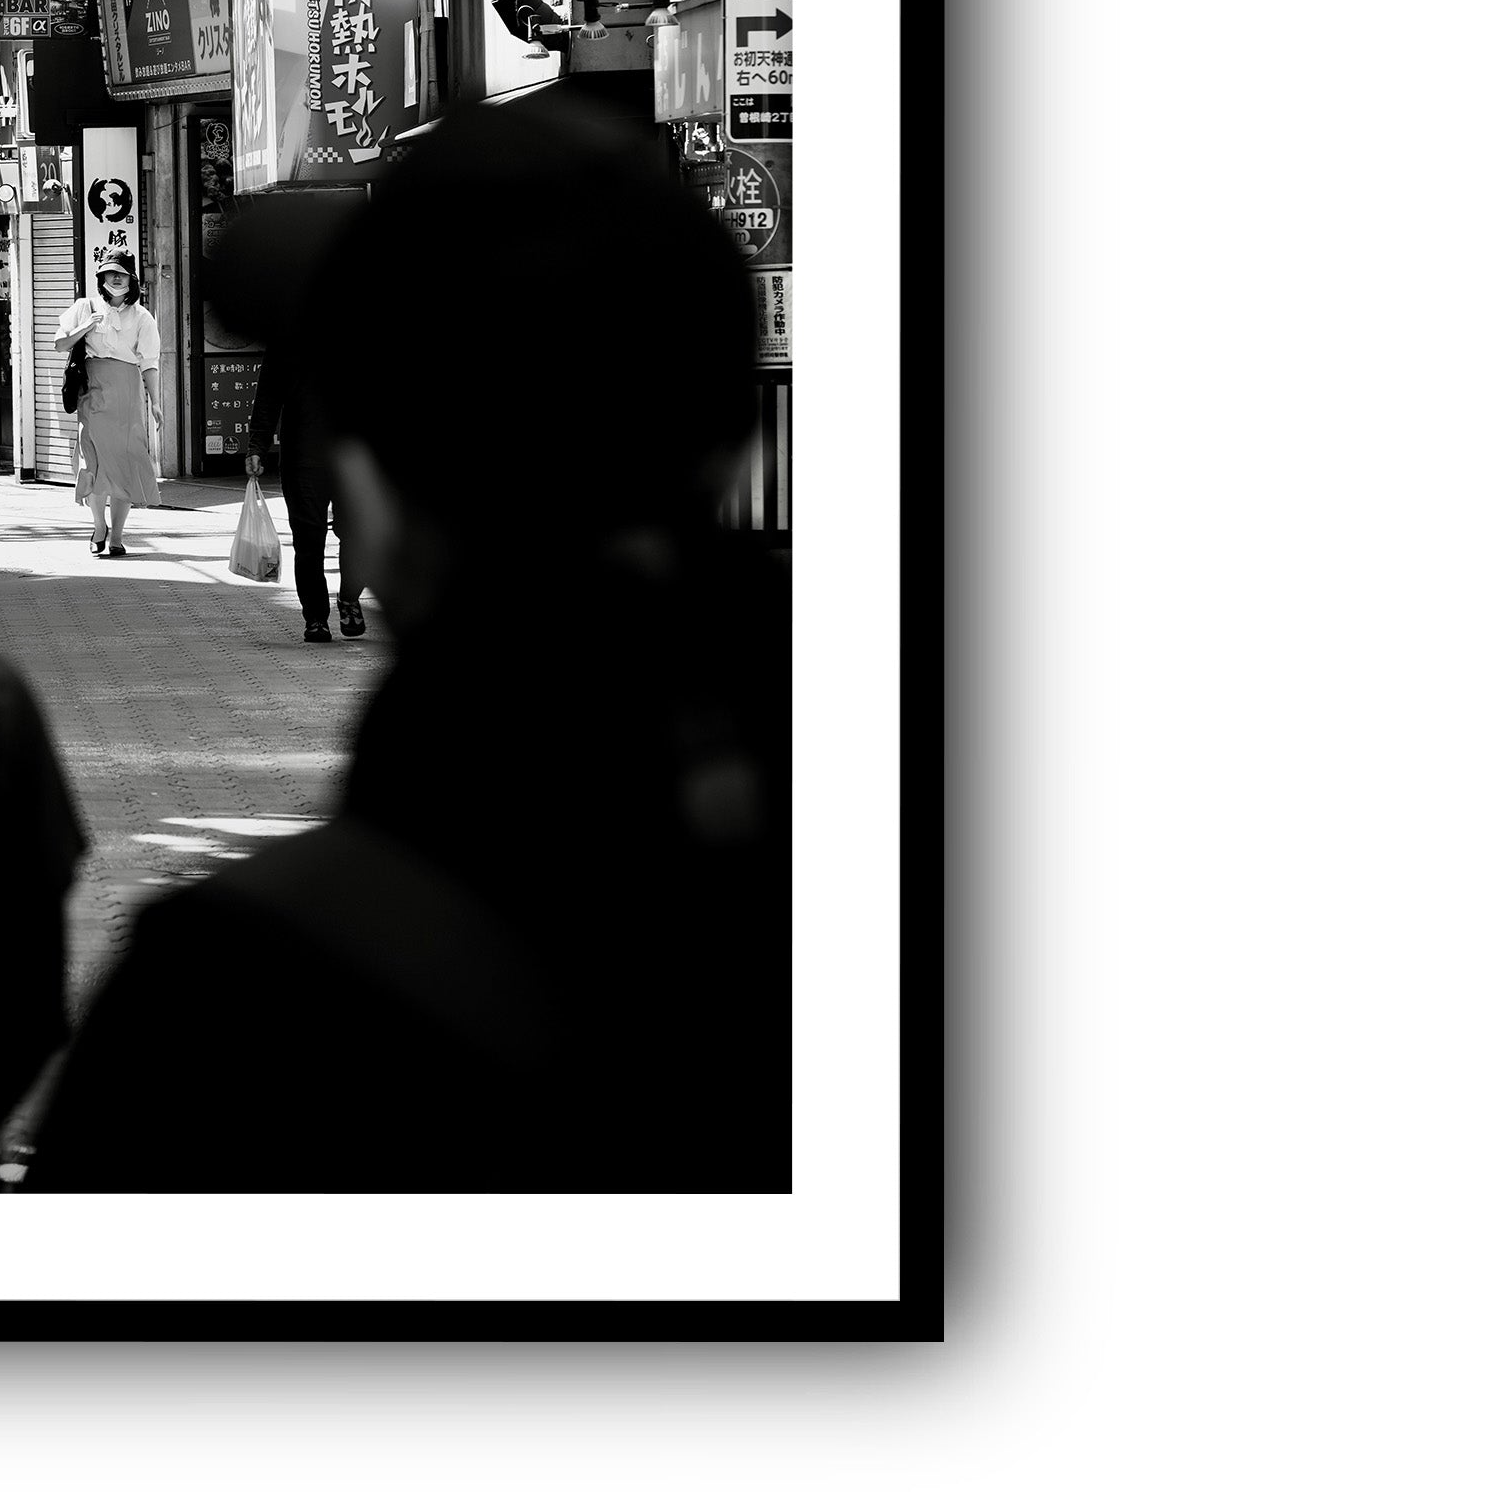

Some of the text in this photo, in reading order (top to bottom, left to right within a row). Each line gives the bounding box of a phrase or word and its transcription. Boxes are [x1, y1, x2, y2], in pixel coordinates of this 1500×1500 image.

[10, 16, 29, 36] 6F
[145, 9, 170, 33] ZINO
[732, 97, 755, 107] ここは
